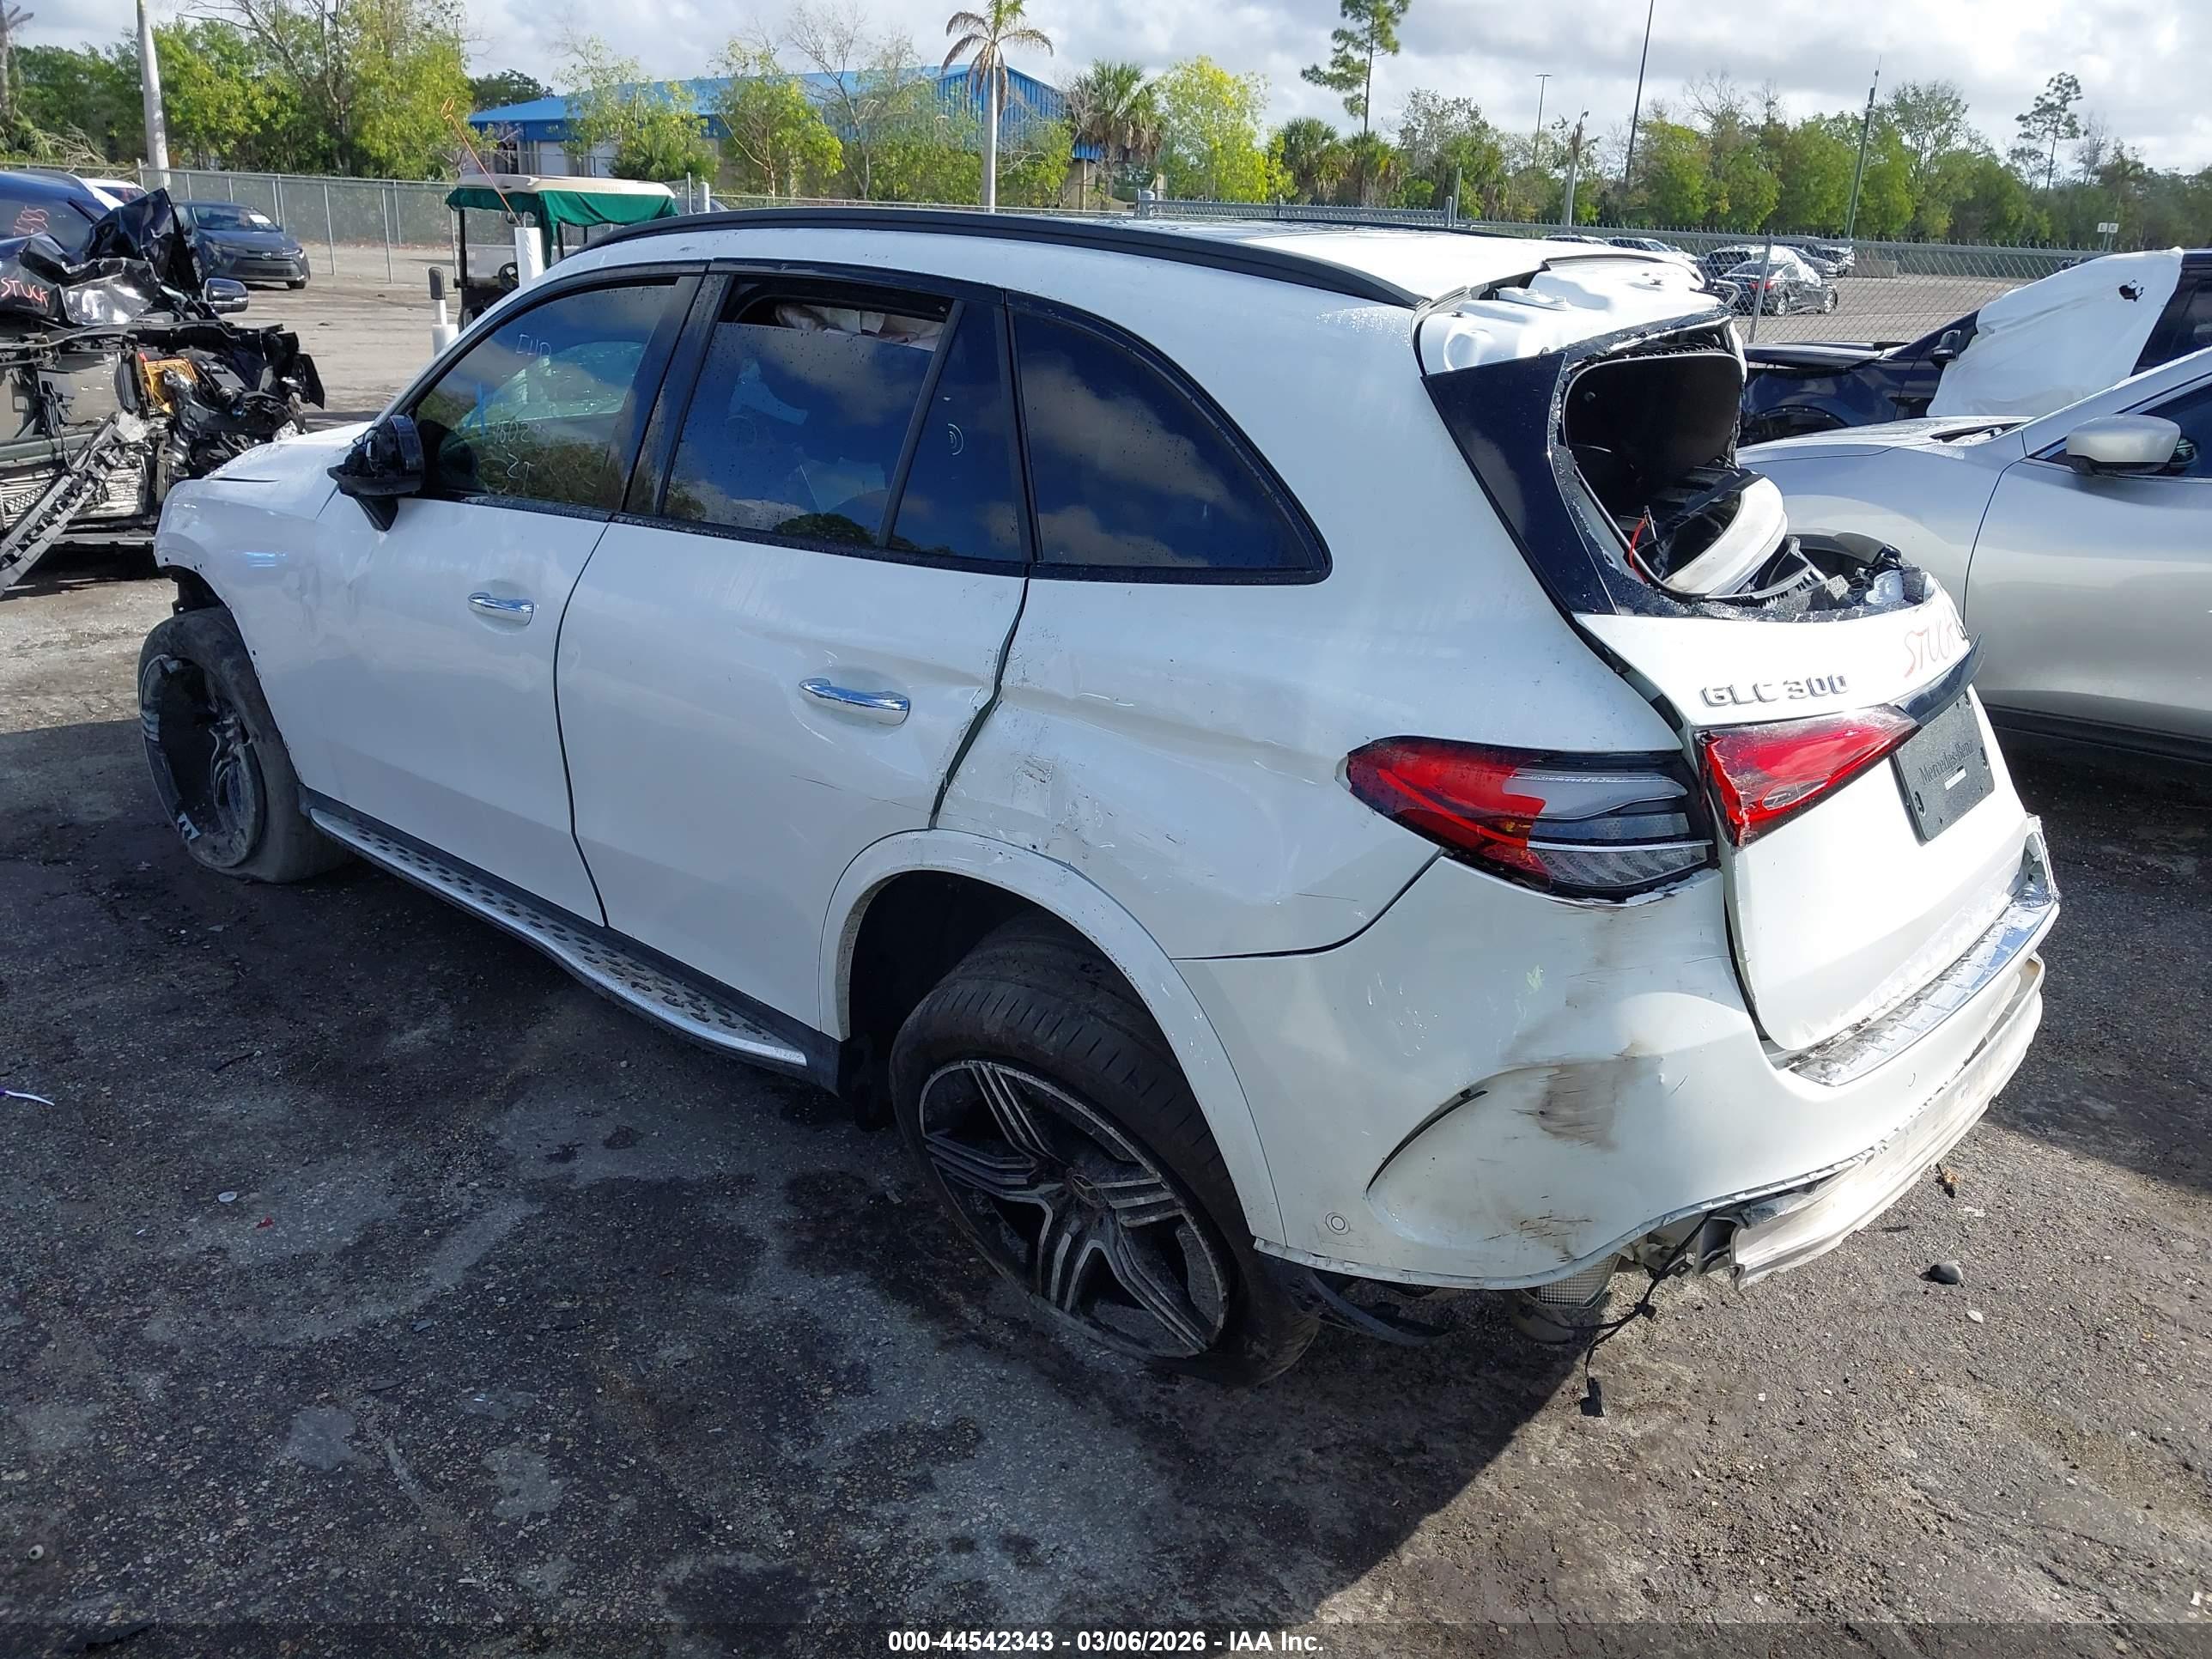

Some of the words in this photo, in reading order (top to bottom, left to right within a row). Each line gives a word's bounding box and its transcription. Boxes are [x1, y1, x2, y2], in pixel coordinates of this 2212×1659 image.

[1, 277, 48, 308] STUCK
[1699, 684, 1778, 708] GLC
[1783, 674, 1848, 699] 300
